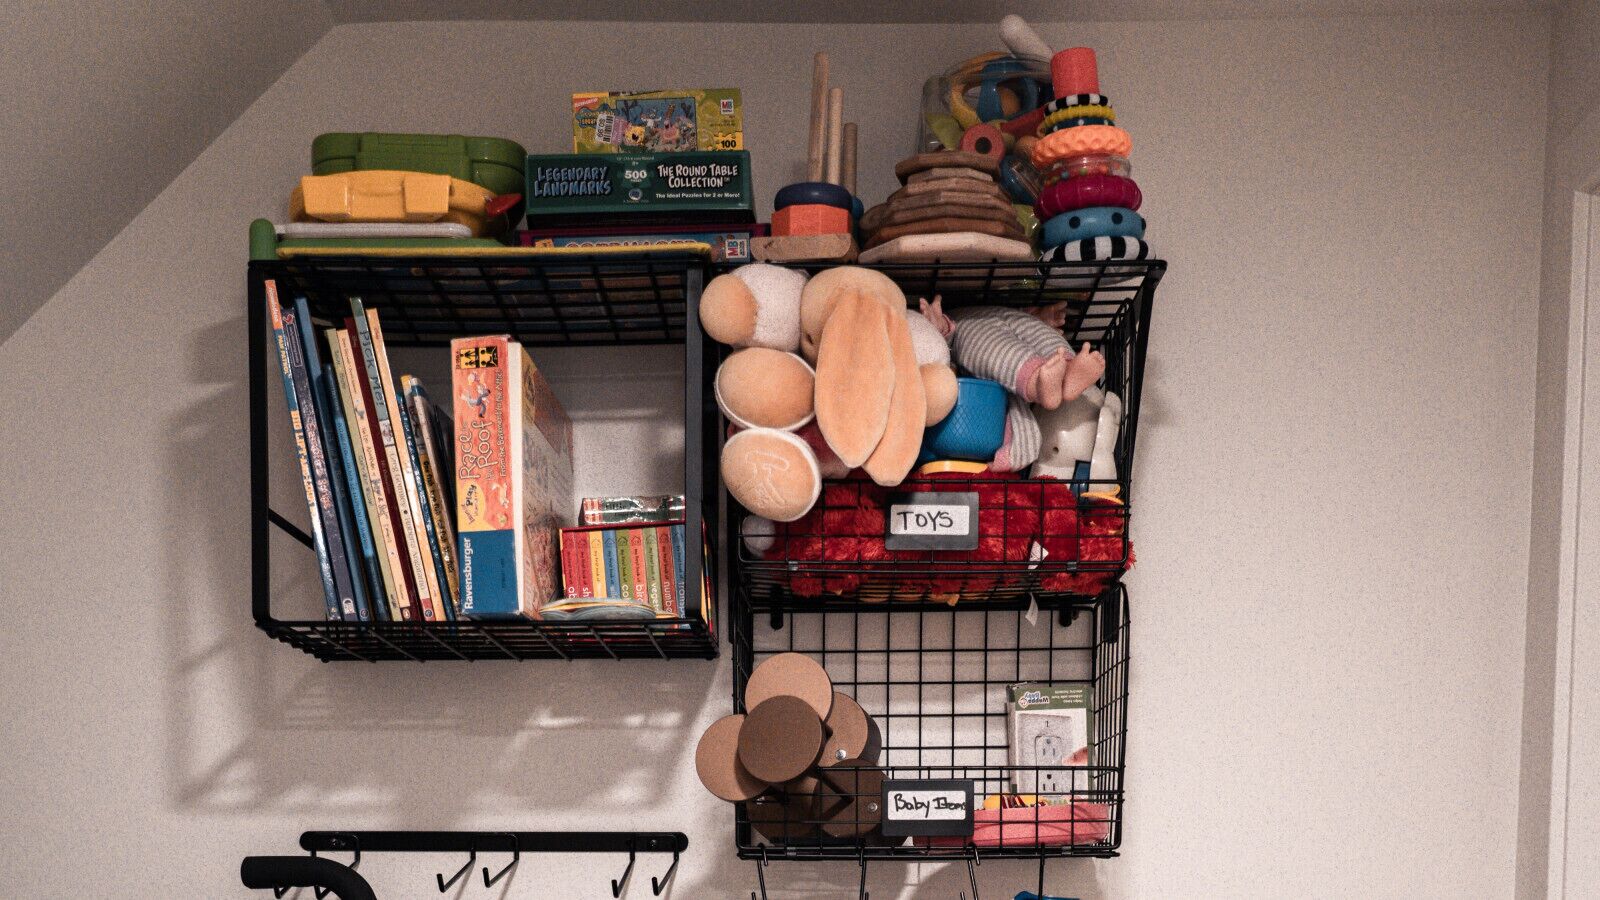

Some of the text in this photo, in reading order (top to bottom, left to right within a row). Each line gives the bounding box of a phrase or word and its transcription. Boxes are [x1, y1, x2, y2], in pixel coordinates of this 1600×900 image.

[721, 140, 737, 148] 100
[537, 166, 608, 182] LEGENDARY
[624, 169, 648, 180] 500
[657, 163, 738, 177] THE ROUND TABLE
[534, 180, 613, 197] LANDMARKS
[668, 176, 724, 188] COLLECTION
[280, 350, 290, 374] PATROL
[359, 330, 384, 406] Pick Me!
[471, 421, 498, 469] Roof
[459, 431, 480, 480] Race
[465, 485, 477, 506] Play
[897, 511, 953, 531] TOYS
[463, 537, 474, 610] Ravensburger
[894, 793, 930, 818] Baby
